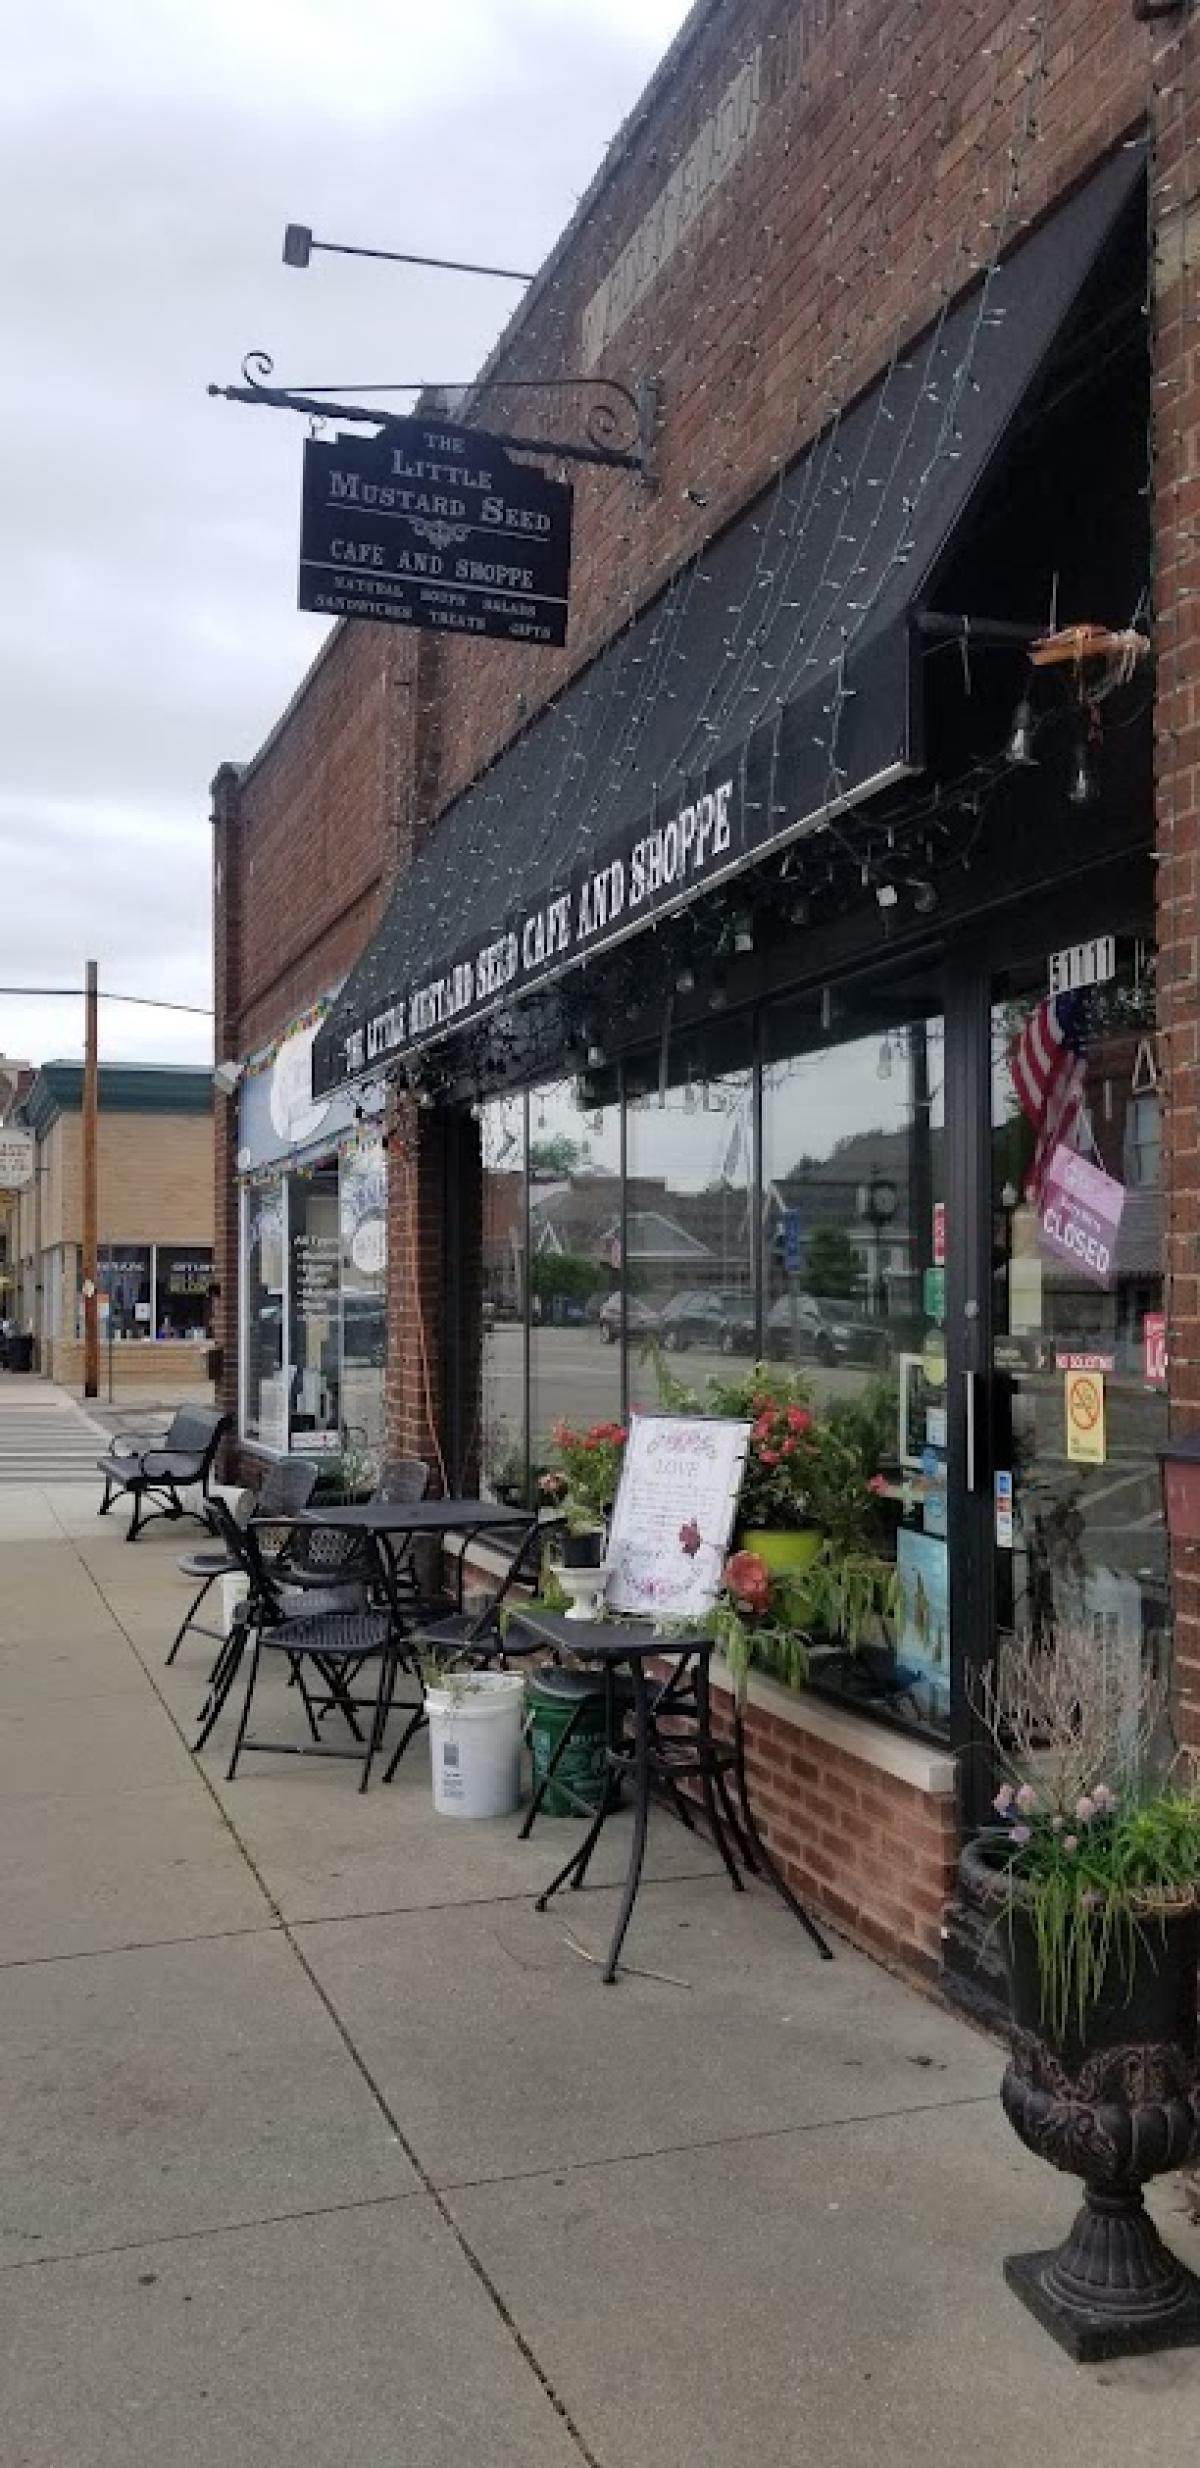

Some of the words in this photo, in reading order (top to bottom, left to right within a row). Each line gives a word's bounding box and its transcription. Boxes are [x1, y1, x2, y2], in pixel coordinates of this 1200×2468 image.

[390, 449, 492, 489] LITTLE
[424, 432, 465, 453] THE
[329, 470, 466, 517] MUSTARD
[481, 497, 550, 531] SEED
[330, 538, 384, 565] CAFE
[397, 550, 443, 575] AND
[455, 558, 533, 590] SHOPPE
[523, 893, 571, 969] CAFE
[577, 858, 625, 941] AND
[629, 779, 733, 906] SHOPPE
[1043, 1208, 1110, 1275] CLOSED
